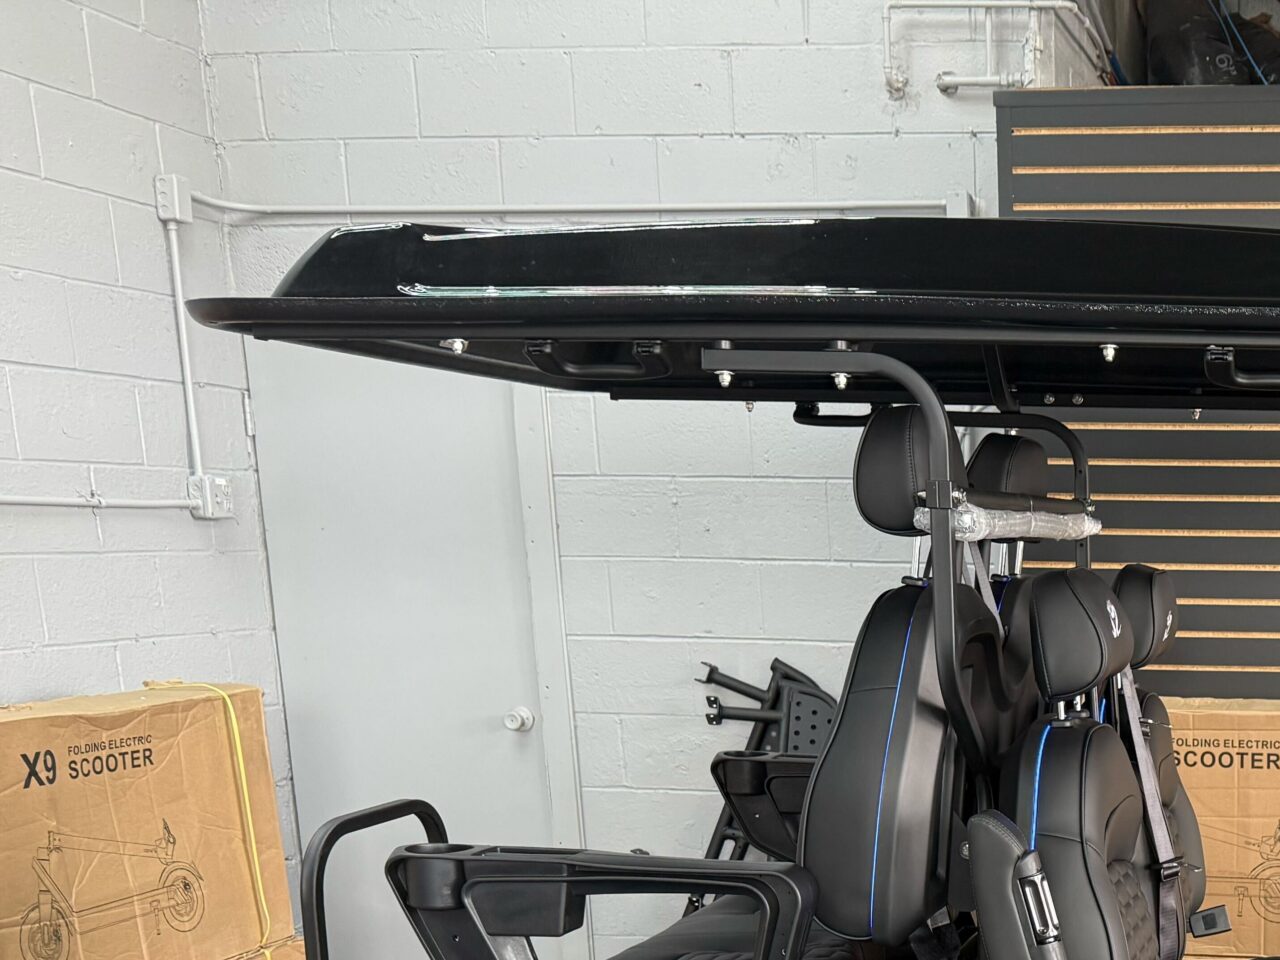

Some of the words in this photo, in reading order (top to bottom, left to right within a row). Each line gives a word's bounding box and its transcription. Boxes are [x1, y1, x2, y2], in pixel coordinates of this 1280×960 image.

[67, 741, 107, 756] FOLDING
[108, 734, 153, 750] ELECTRIC
[1223, 739, 1280, 750] ELECTRIC
[20, 749, 57, 789] X9
[68, 748, 154, 779] SCOOTER
